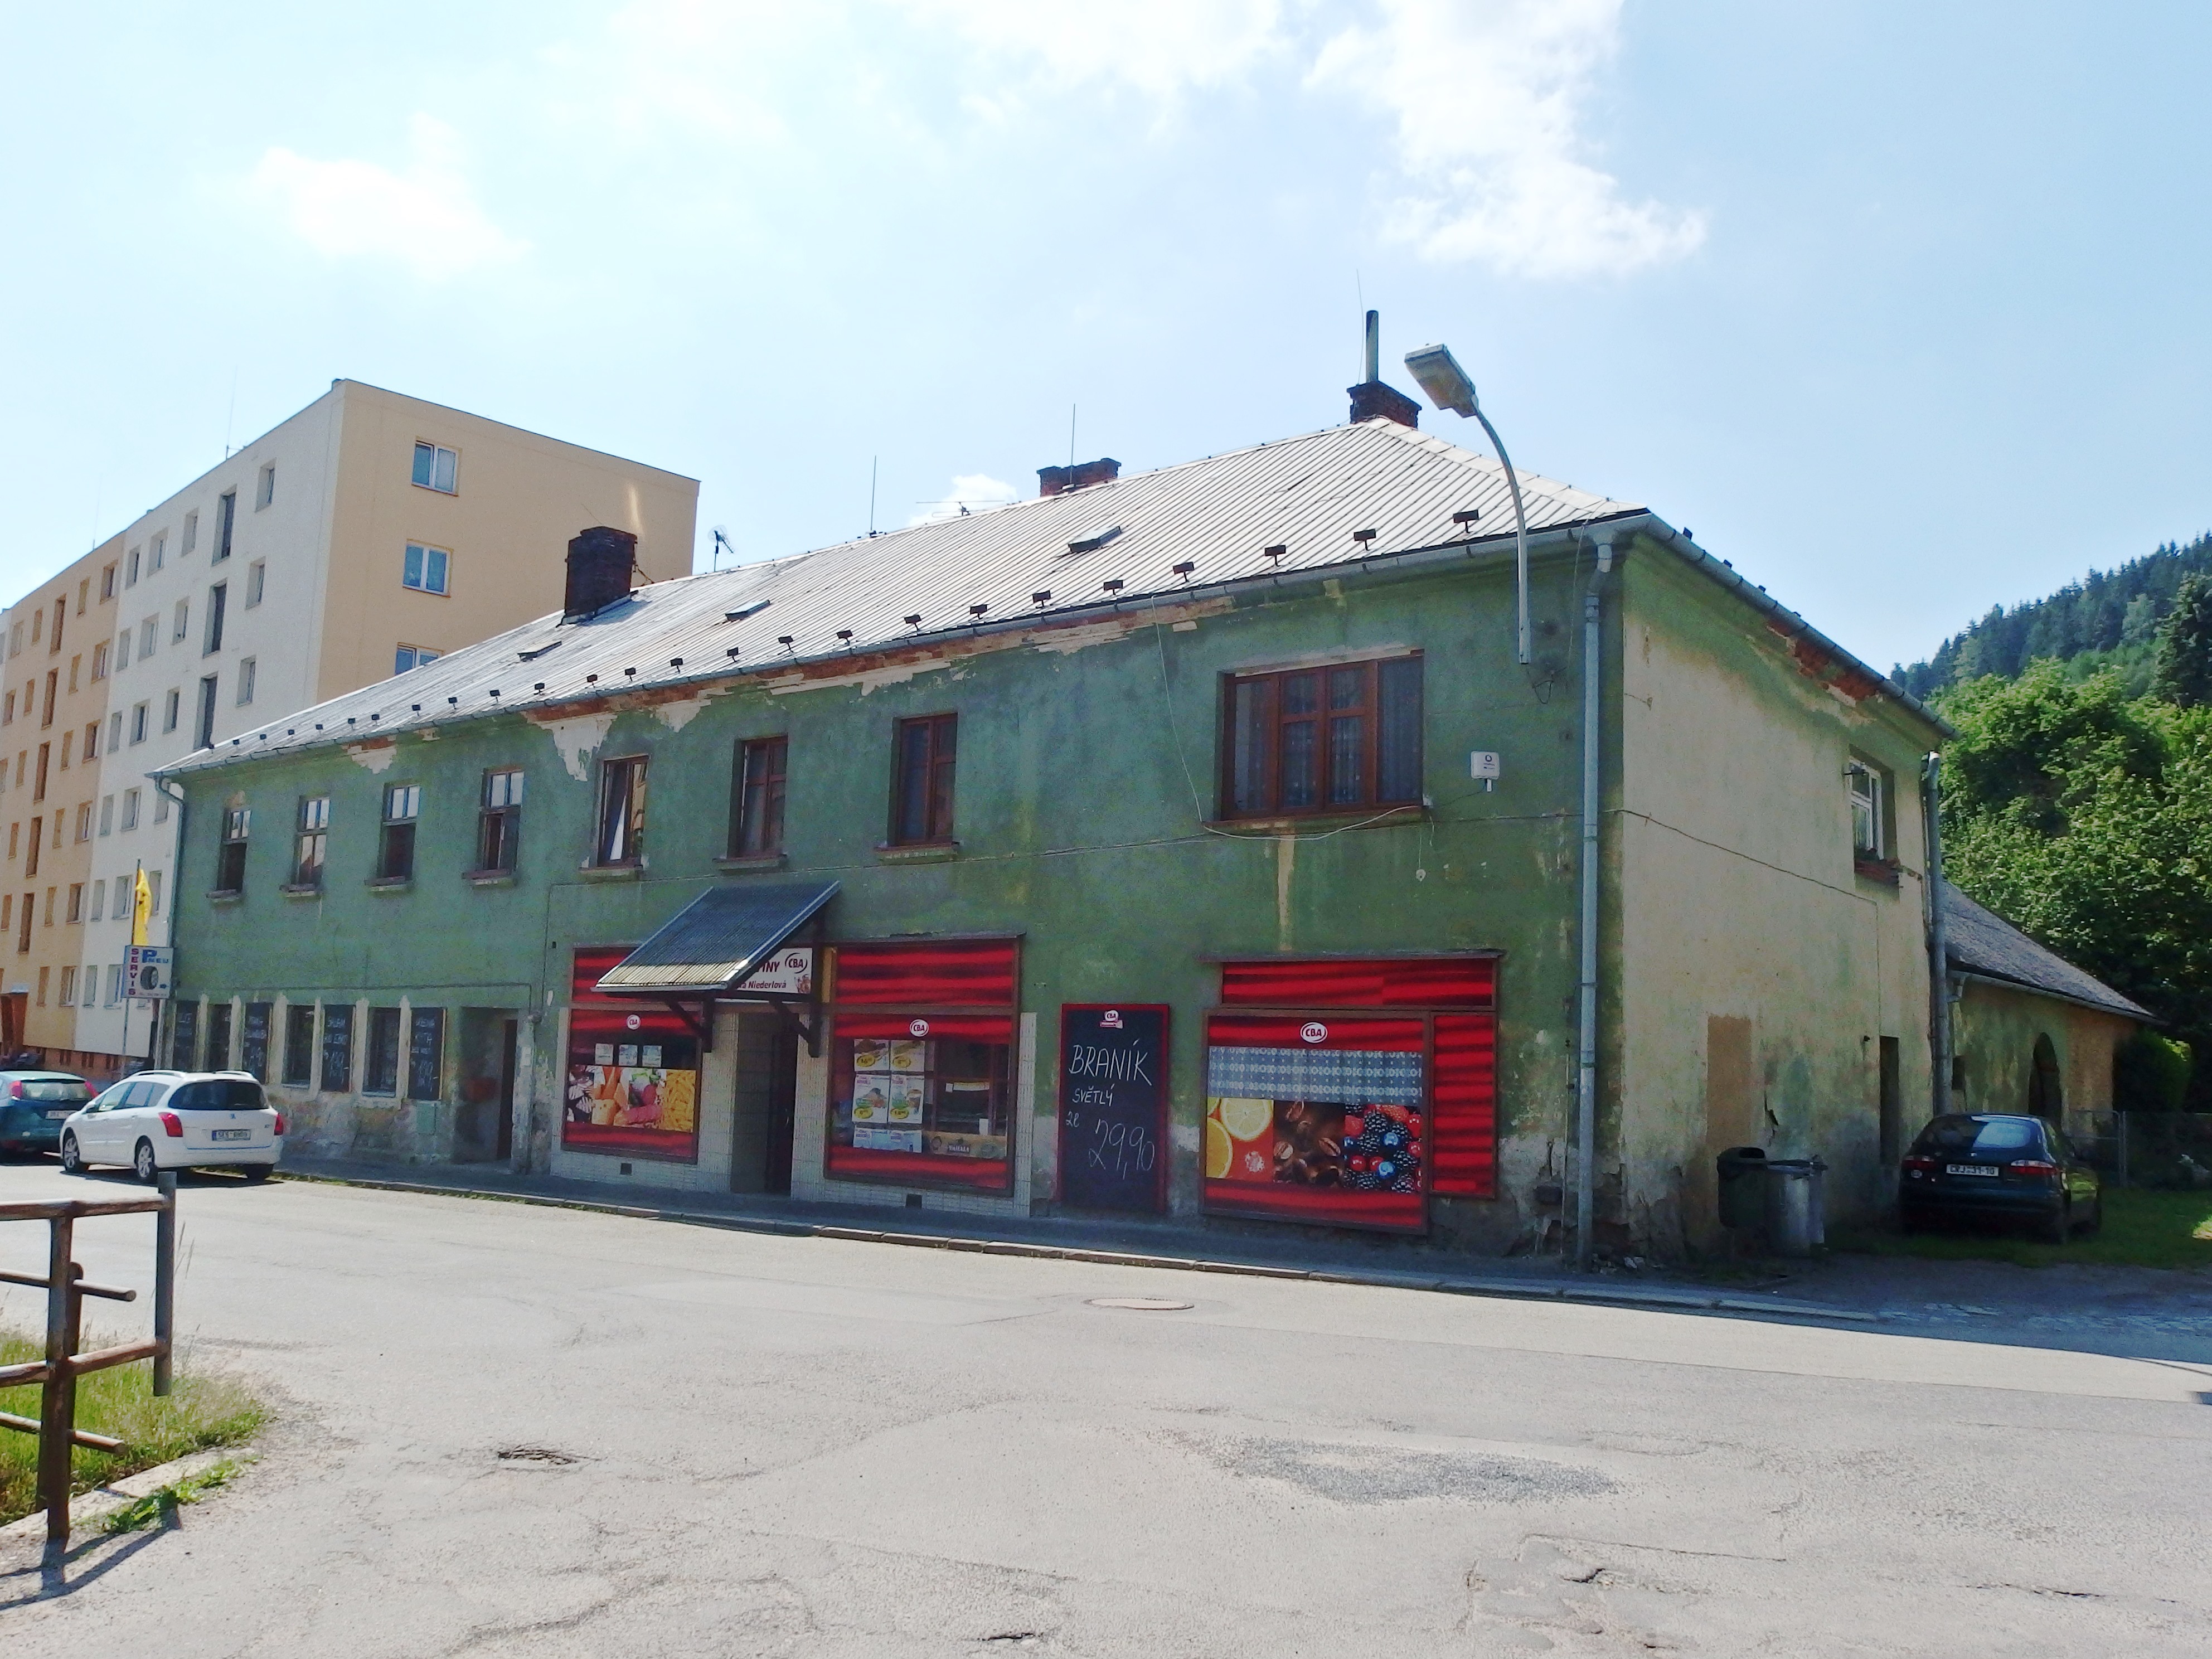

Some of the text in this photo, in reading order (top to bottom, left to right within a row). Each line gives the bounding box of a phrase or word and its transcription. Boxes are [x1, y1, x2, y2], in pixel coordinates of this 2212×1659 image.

[128, 948, 139, 995] SERVIS
[761, 961, 780, 972] INY
[788, 958, 803, 968] CBA
[748, 980, 787, 989] Niederlová
[1305, 1028, 1322, 1037] CBA
[1068, 1039, 1152, 1086] BRANÍK
[1072, 1083, 1115, 1107] SVĚTLÝ
[1089, 1118, 1155, 1180] 29,90
